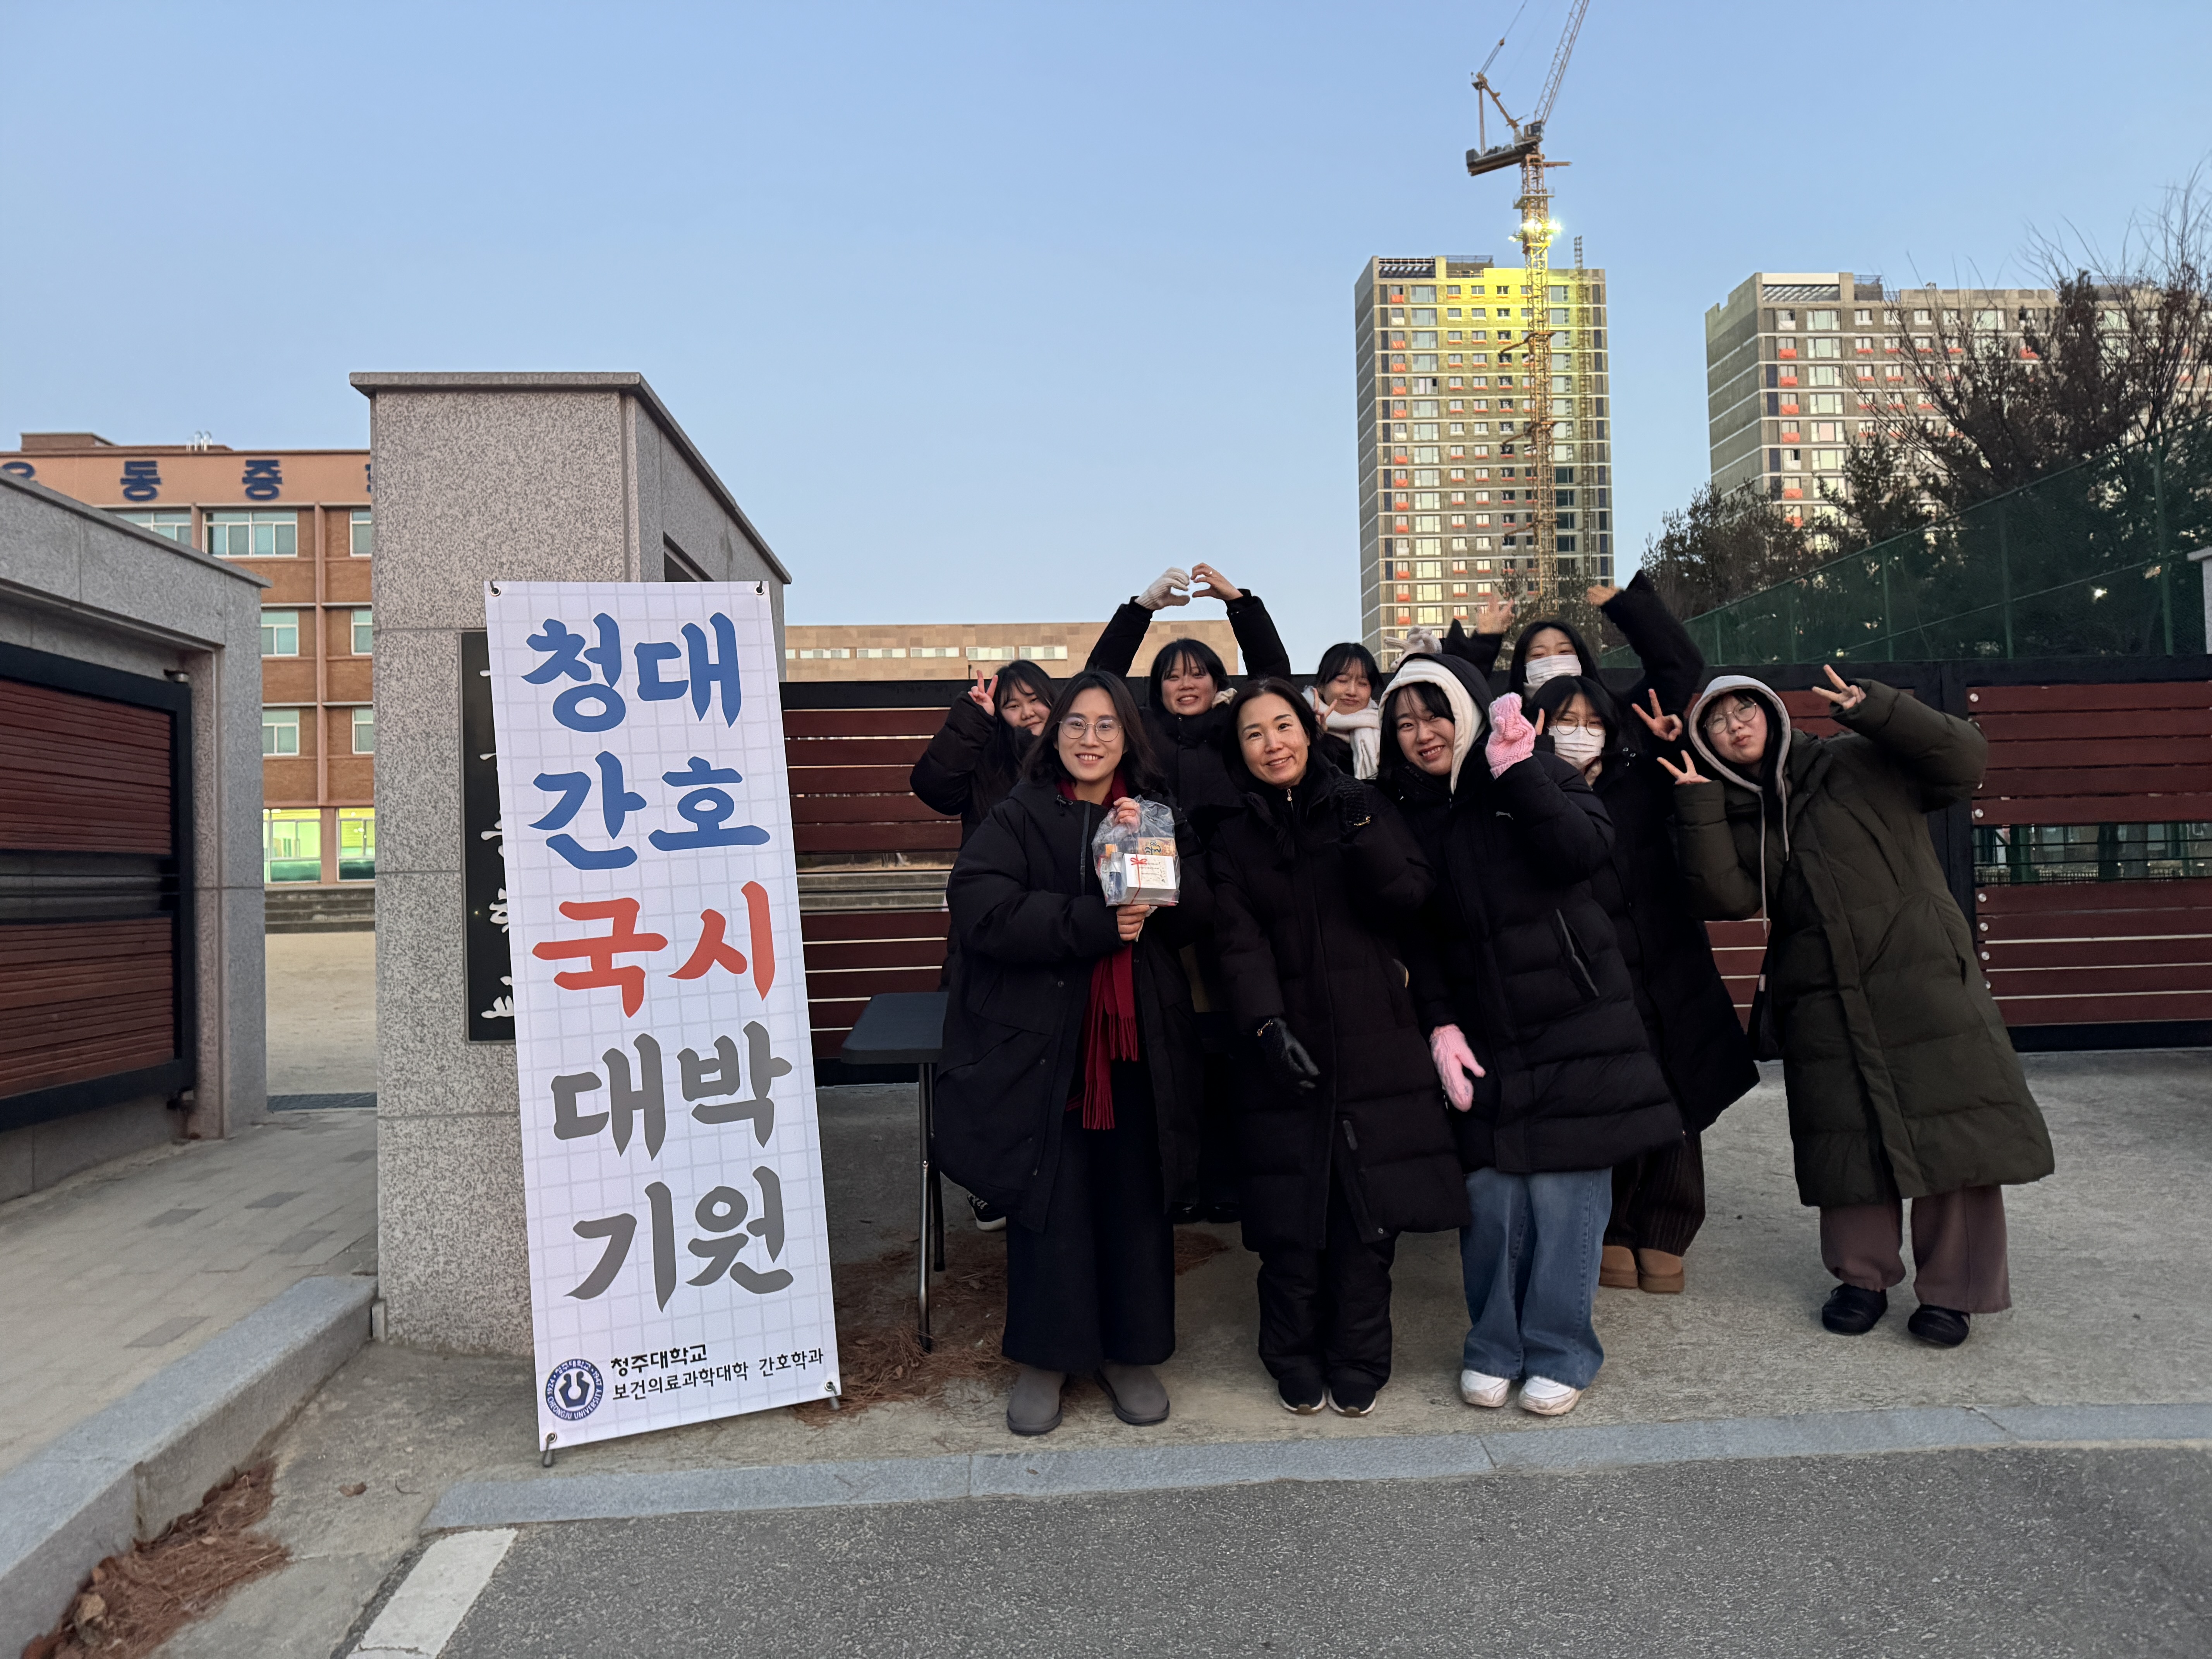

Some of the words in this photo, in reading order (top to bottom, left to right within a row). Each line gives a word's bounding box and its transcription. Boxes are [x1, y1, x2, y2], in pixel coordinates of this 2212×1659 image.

[521, 613, 741, 732] 청대
[528, 751, 770, 870] 간호
[532, 881, 775, 1018] 국시
[551, 1021, 792, 1161] 대박
[564, 1166, 794, 1313] 기원
[547, 1396, 572, 1419] CHEONGJU
[574, 1388, 602, 1419] UNIVERSITY
[611, 1344, 707, 1376] 청주대학교
[613, 1361, 749, 1400] 보건의료과학대학
[759, 1348, 824, 1377] 간호학과
